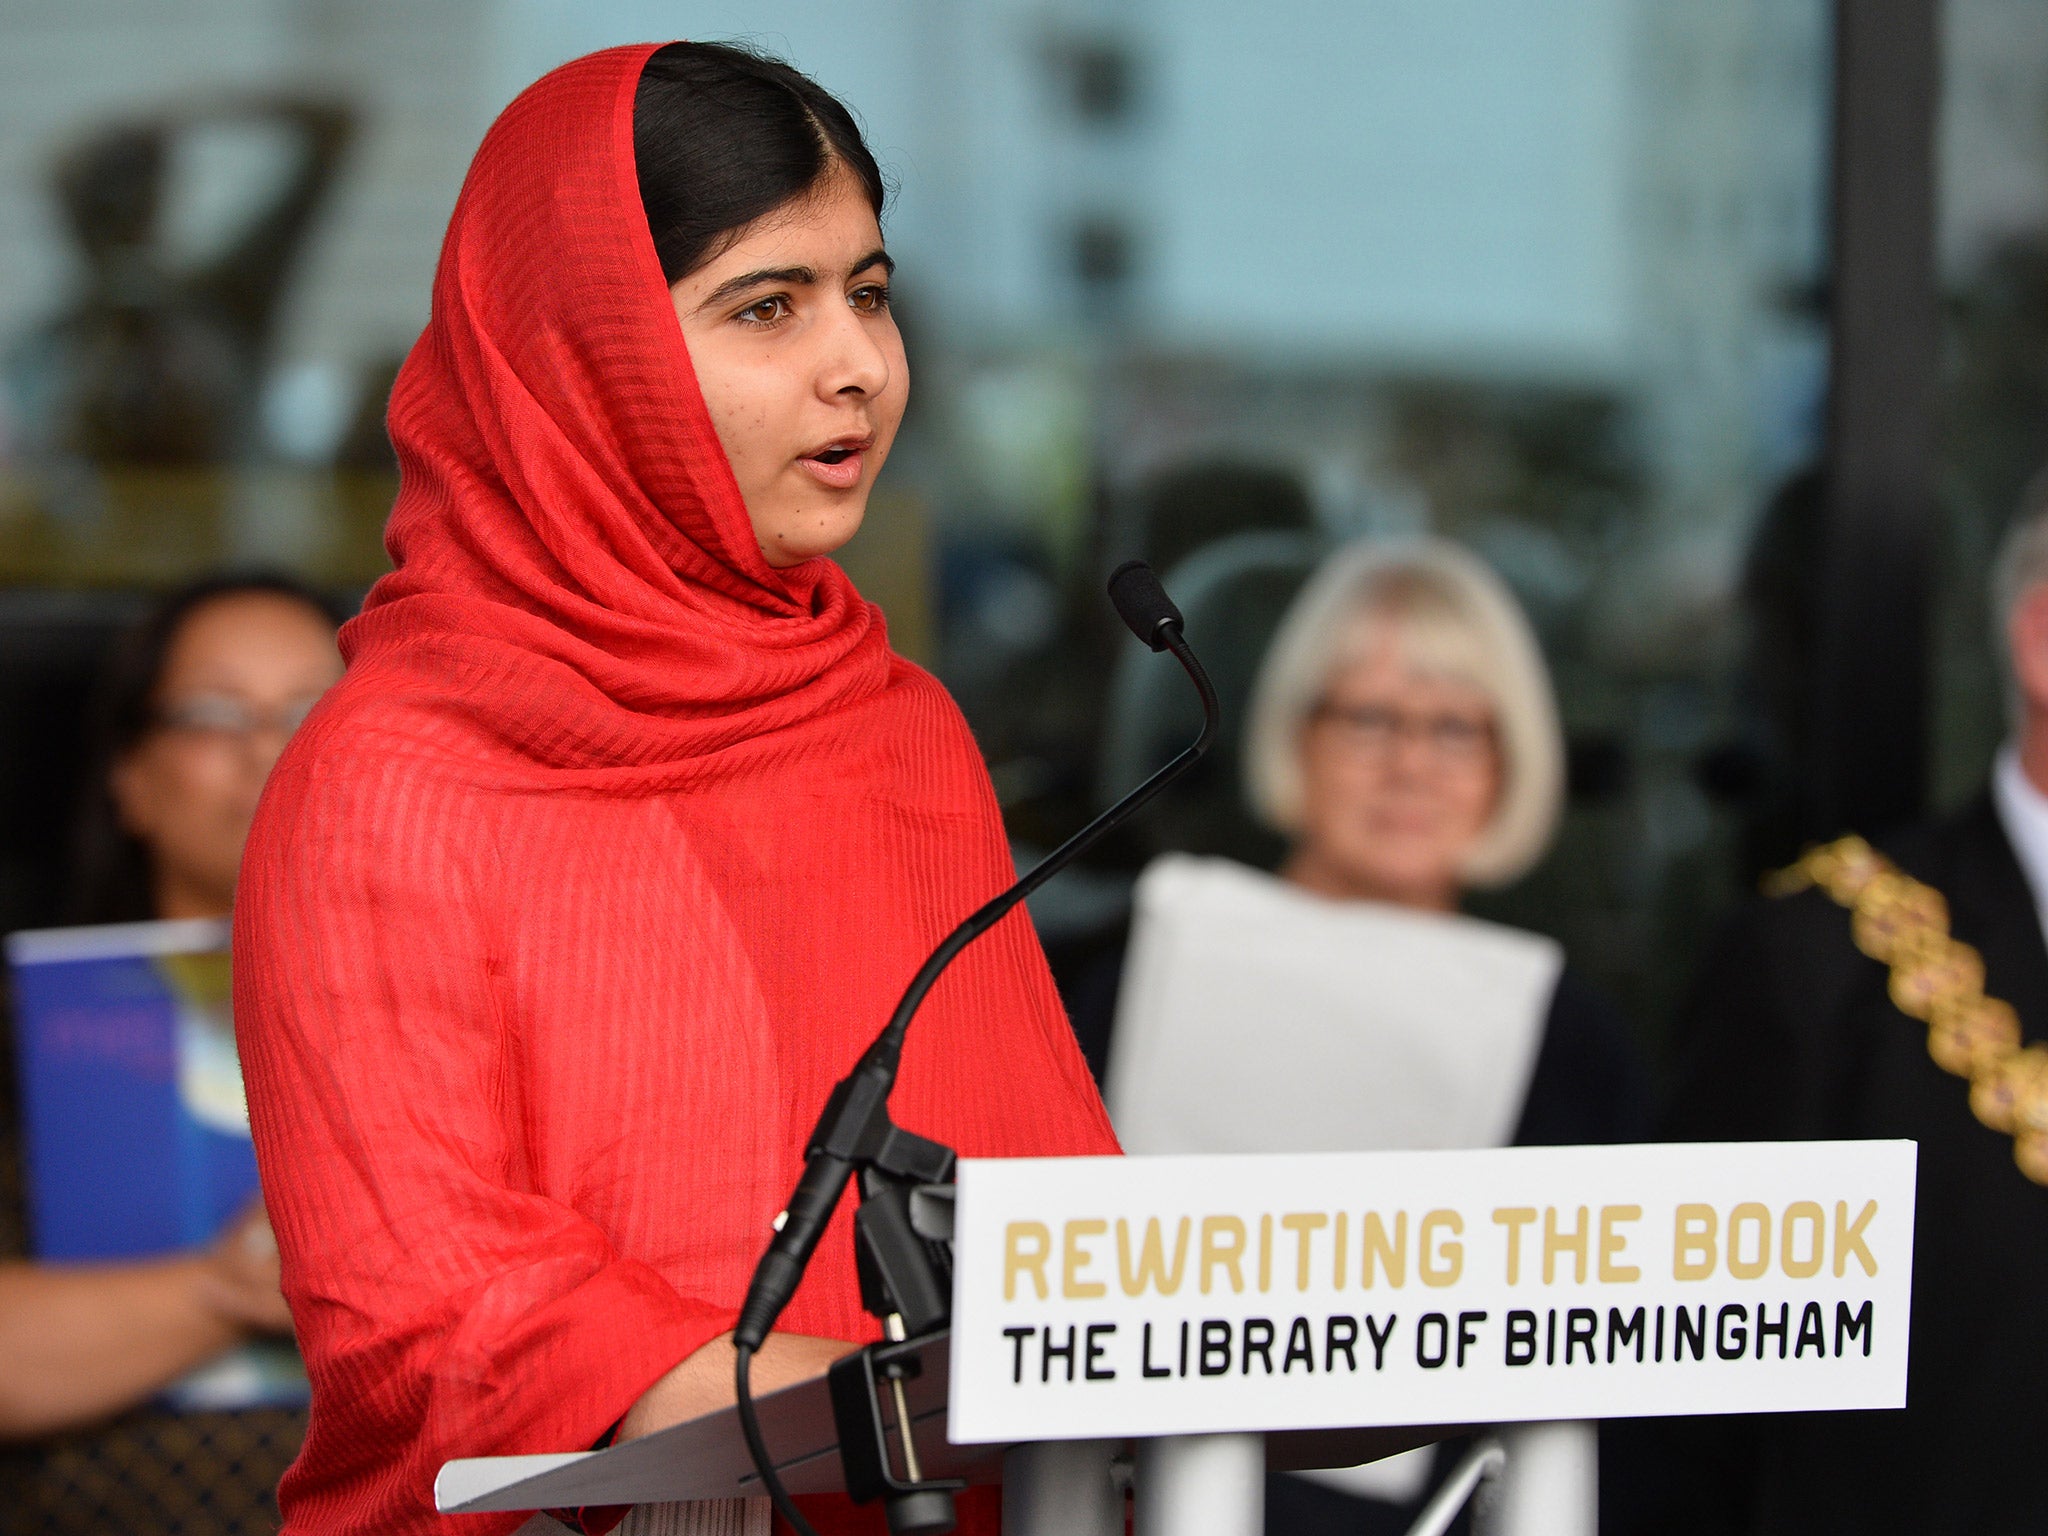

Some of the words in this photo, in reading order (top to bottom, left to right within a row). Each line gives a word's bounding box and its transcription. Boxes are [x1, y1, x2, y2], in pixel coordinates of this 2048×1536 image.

[1003, 1209, 1464, 1302] REWRITING
[1492, 1205, 1643, 1287] THE
[1673, 1199, 1878, 1282] BOOK
[1002, 1323, 1117, 1384] THE
[1142, 1313, 1397, 1379] LIBRARY
[1416, 1311, 1488, 1369] OF
[1505, 1300, 1873, 1367] BIRMINGHAM
